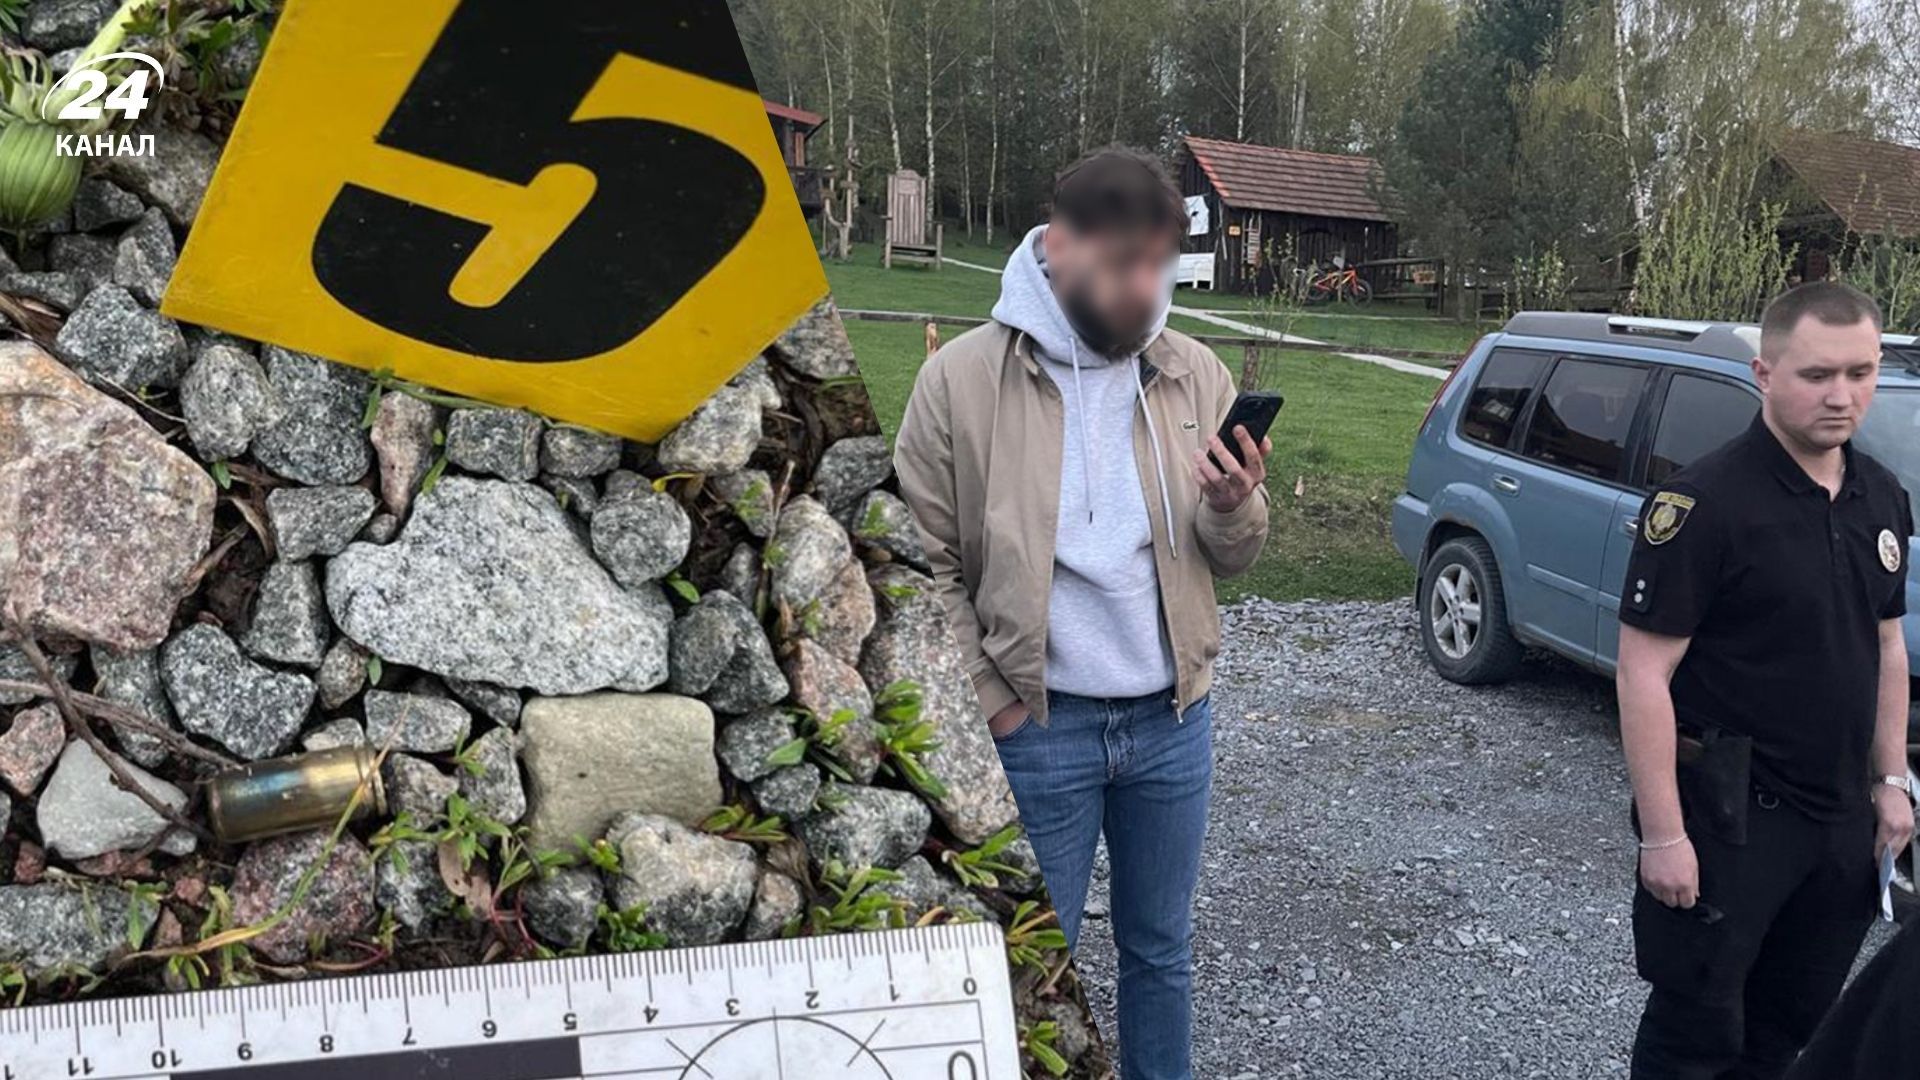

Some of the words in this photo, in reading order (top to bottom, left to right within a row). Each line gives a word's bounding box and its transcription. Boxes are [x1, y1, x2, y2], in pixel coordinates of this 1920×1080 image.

[311, 0, 766, 363] 5
[889, 984, 901, 1002] 1
[963, 978, 977, 996] 0
[725, 998, 740, 1016] 3
[804, 991, 820, 1009] 2
[563, 1013, 578, 1031] 5
[643, 1005, 659, 1024] 4
[402, 1027, 417, 1046] 7
[482, 1020, 497, 1038] 6
[237, 1043, 253, 1061] 9
[319, 1035, 334, 1053] 8
[68, 1057, 95, 1077] 11
[151, 1049, 182, 1069] 10
